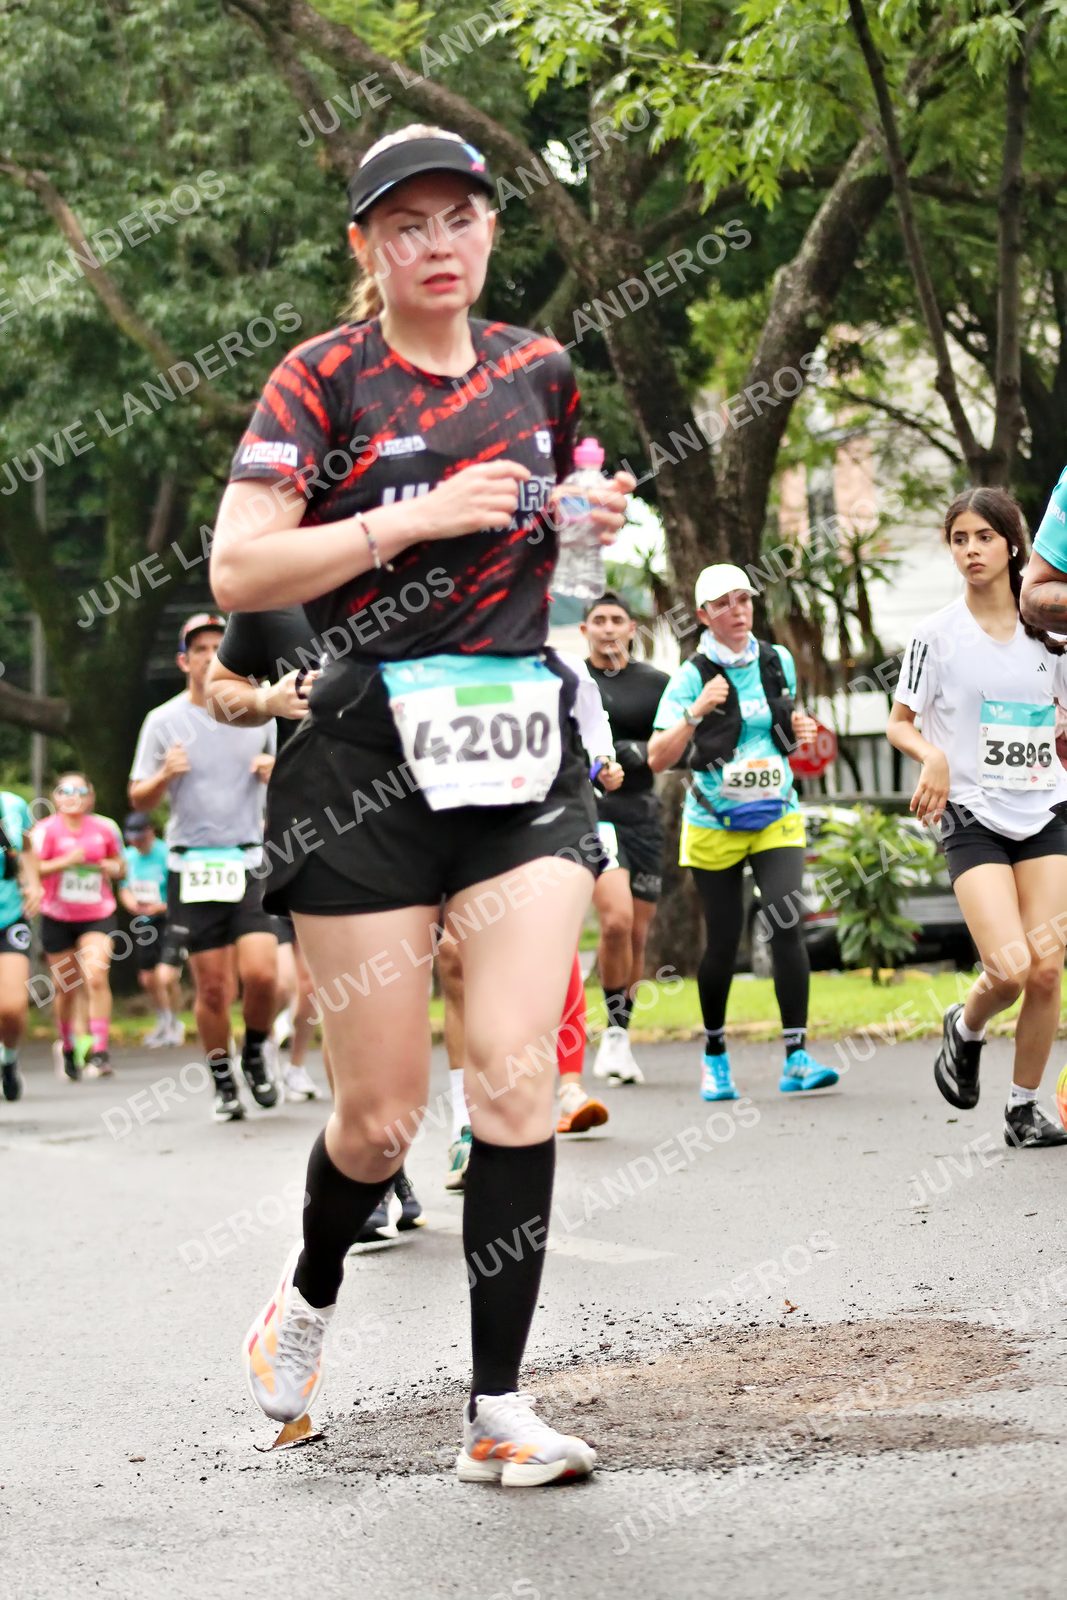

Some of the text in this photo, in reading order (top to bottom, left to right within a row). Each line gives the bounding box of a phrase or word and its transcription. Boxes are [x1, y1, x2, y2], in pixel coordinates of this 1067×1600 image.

[413, 711, 551, 765] 4200
[983, 739, 1053, 768] 3896
[728, 768, 781, 788] 3989
[188, 870, 238, 888] 3210
